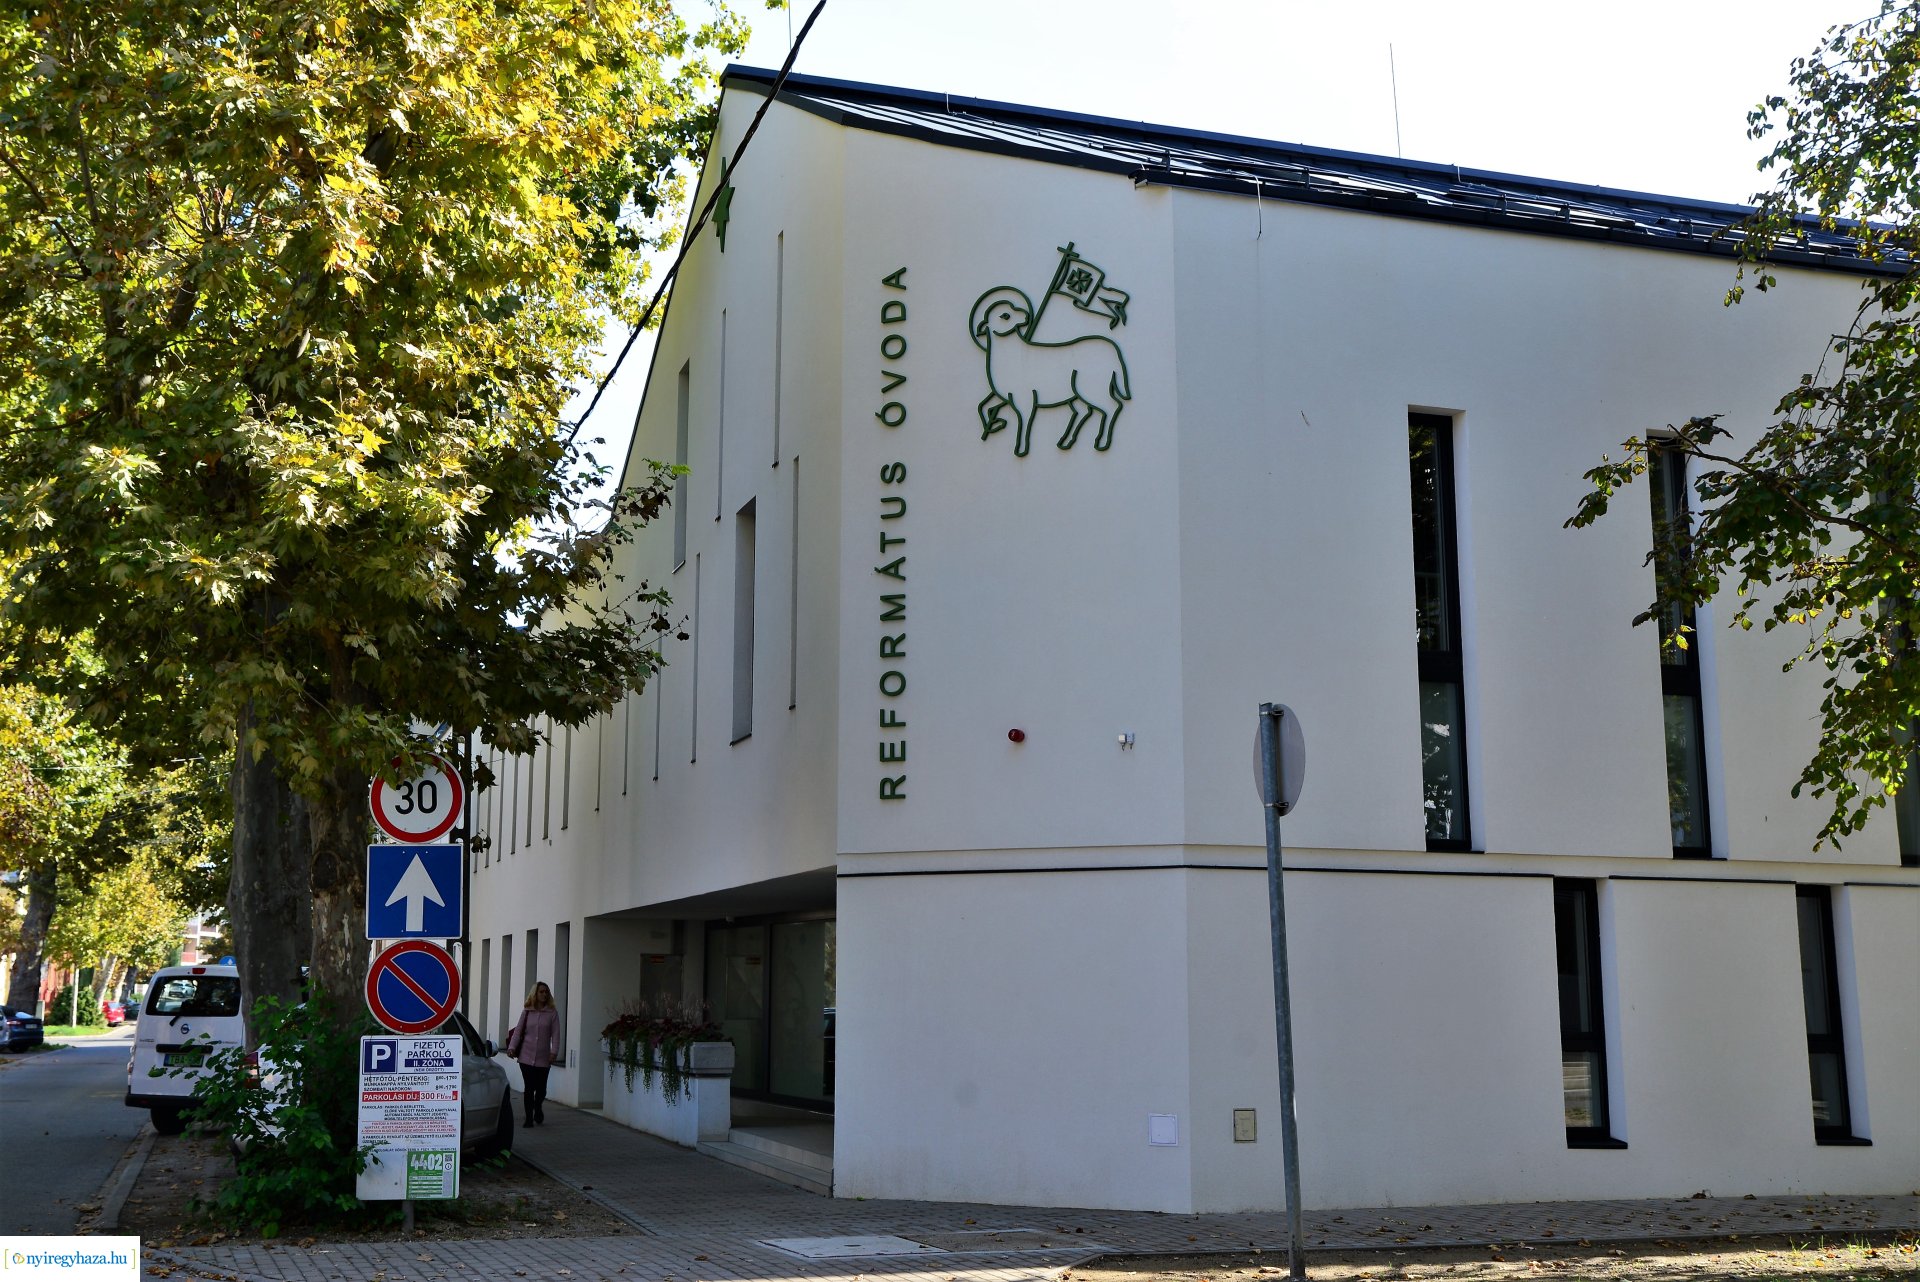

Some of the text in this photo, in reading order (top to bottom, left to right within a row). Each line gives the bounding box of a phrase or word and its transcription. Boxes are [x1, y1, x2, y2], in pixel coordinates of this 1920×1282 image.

[873, 266, 907, 800] REFORMÁTUS ÓVODA
[395, 779, 437, 815] 30
[413, 1040, 446, 1049] FIZETŐ
[371, 1044, 391, 1070] P
[407, 1049, 452, 1058] PARKOLÓ
[422, 1059, 445, 1067] ZÓNA
[363, 1093, 405, 1101] PARKOLÁSI
[420, 1092, 435, 1100] 300
[410, 1153, 443, 1171] 4402
